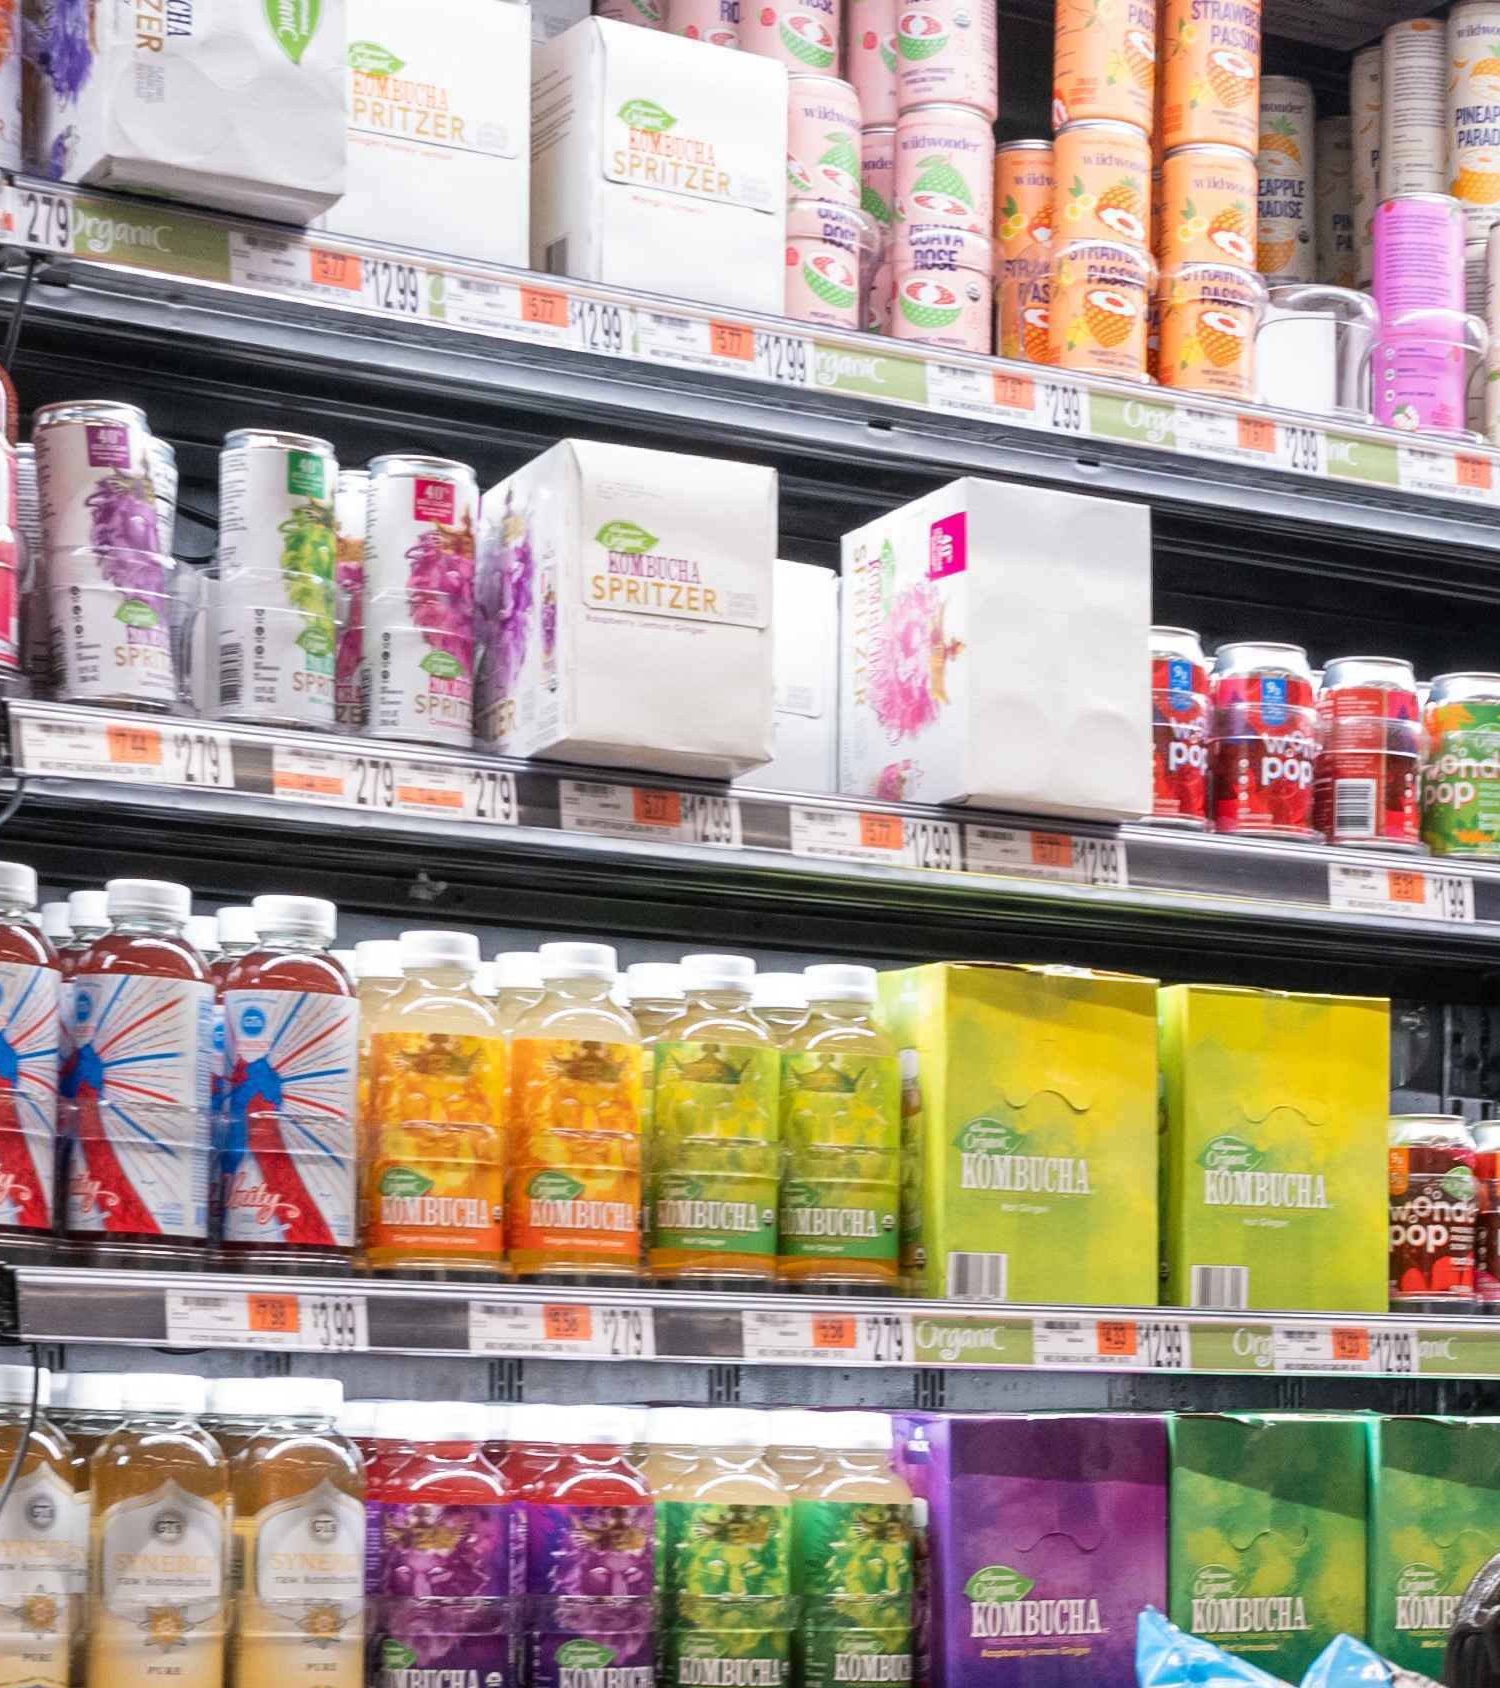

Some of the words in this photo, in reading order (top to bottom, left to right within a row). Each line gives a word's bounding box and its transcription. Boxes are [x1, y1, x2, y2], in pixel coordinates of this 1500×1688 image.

[349, 100, 465, 142] PRITZER
[613, 152, 731, 196] SPRITZER
[607, 552, 702, 585] KOMBUCHA
[592, 575, 719, 614] SPRITZER
[1262, 758, 1312, 787] pop
[960, 1150, 1094, 1196] KOMBUCHA
[1204, 1171, 1330, 1211] KOMBUCHA
[380, 1198, 491, 1230] KOMBUCHA
[529, 1200, 639, 1232] KOMBUCHA
[658, 1201, 761, 1232] KOMBUCHA
[915, 1319, 1005, 1362] Organic
[970, 1598, 1102, 1638] KOMBUCHA
[1191, 1595, 1306, 1632] KOMBUCHA
[678, 1656, 781, 1686] KOMBUCHA
